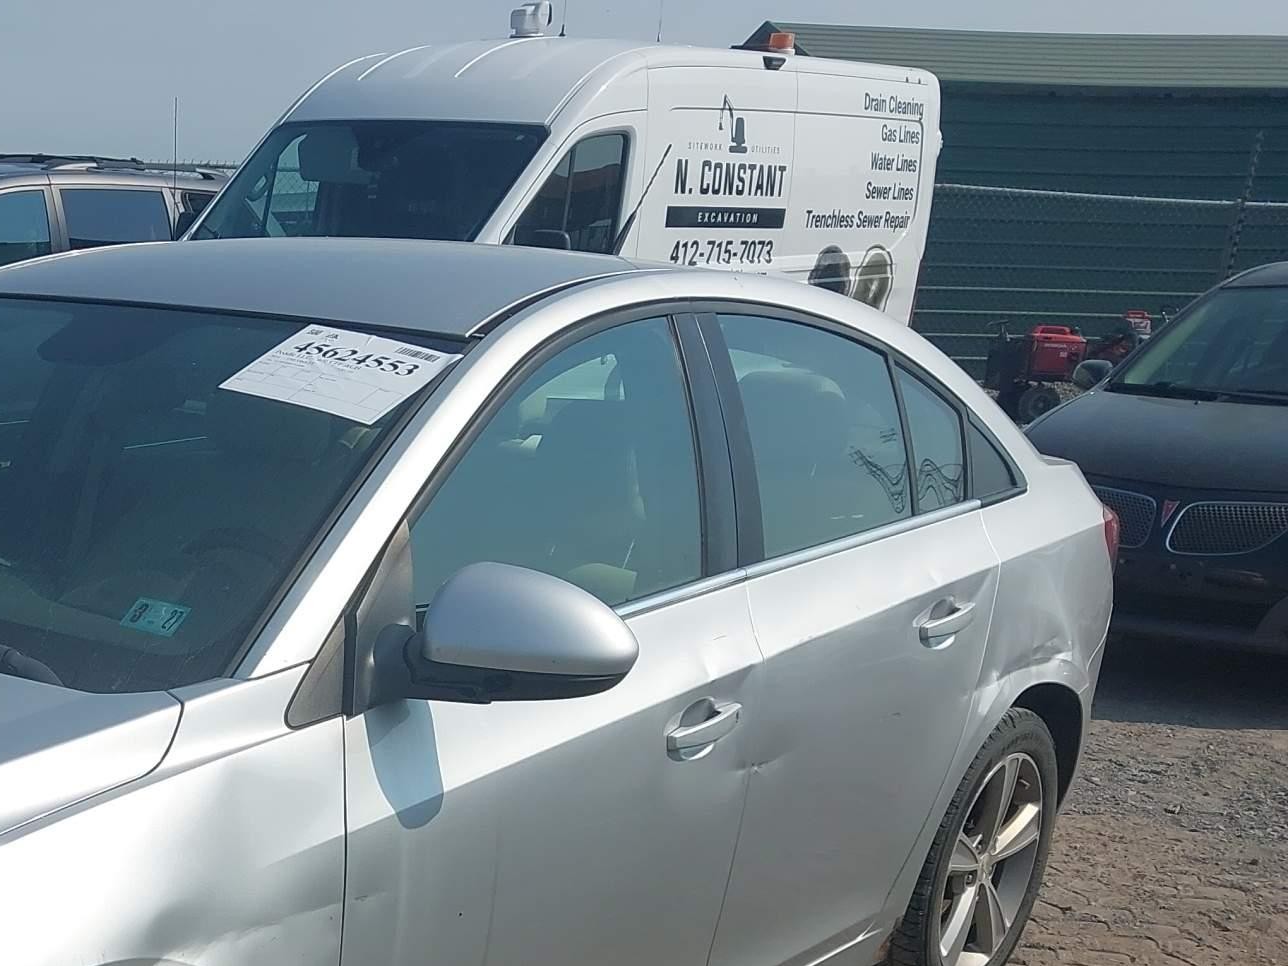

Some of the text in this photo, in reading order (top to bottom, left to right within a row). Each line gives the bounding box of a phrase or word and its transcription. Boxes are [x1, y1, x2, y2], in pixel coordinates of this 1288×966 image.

[864, 92, 924, 121] Drain Cleaning
[881, 124, 920, 145] Gas Lines
[751, 145, 781, 154] UTILITIES
[871, 151, 918, 173] Water Lines
[674, 158, 787, 198] N. CONSTANT
[865, 181, 914, 201] Sewer Lines
[697, 212, 760, 224] EXCAVATION
[805, 208, 911, 233] Trenchless Sewer Repair
[670, 239, 774, 266] 412-715-7073
[293, 341, 421, 377] 45624553
